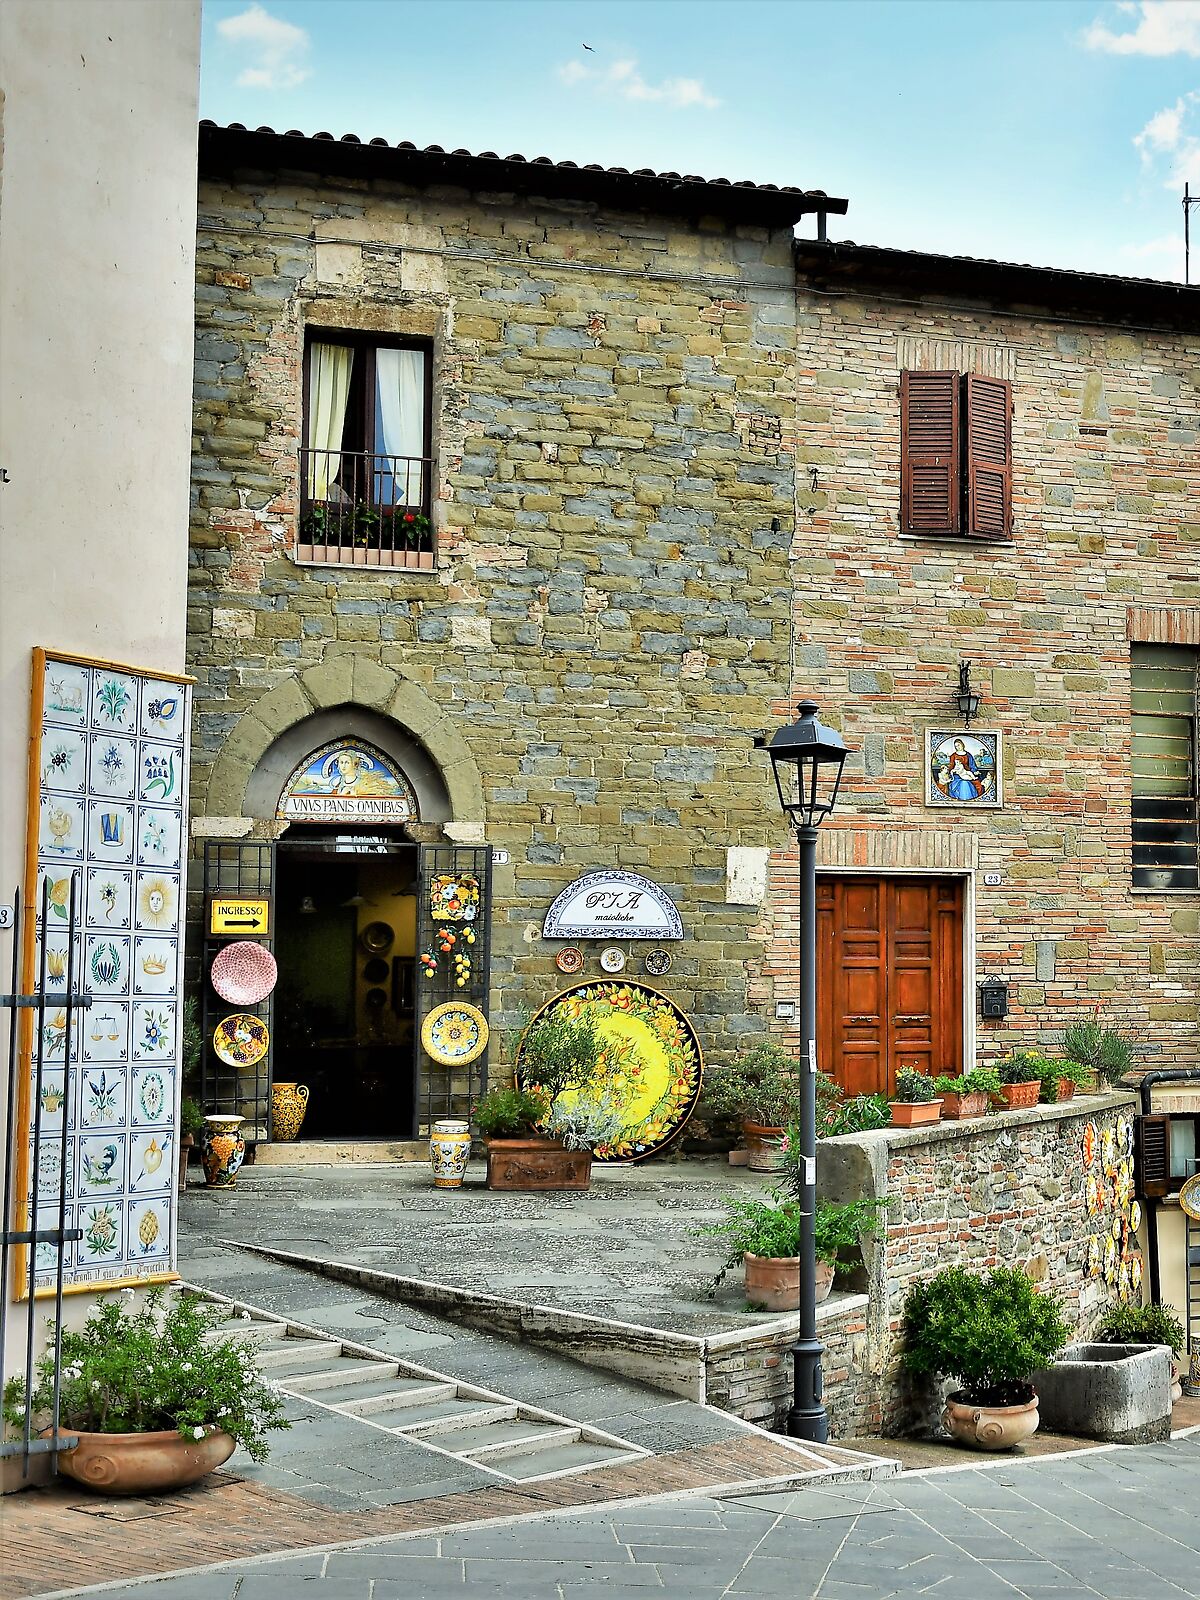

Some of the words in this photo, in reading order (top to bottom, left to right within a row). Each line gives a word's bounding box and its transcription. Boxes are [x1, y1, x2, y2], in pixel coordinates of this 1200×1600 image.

[323, 800, 355, 813] PANIS
[357, 800, 404, 814] OMNIBVS
[492, 852, 501, 861] 21
[987, 874, 999, 884] 23
[218, 906, 263, 916] INGRESSO
[595, 912, 635, 922] maioliche
